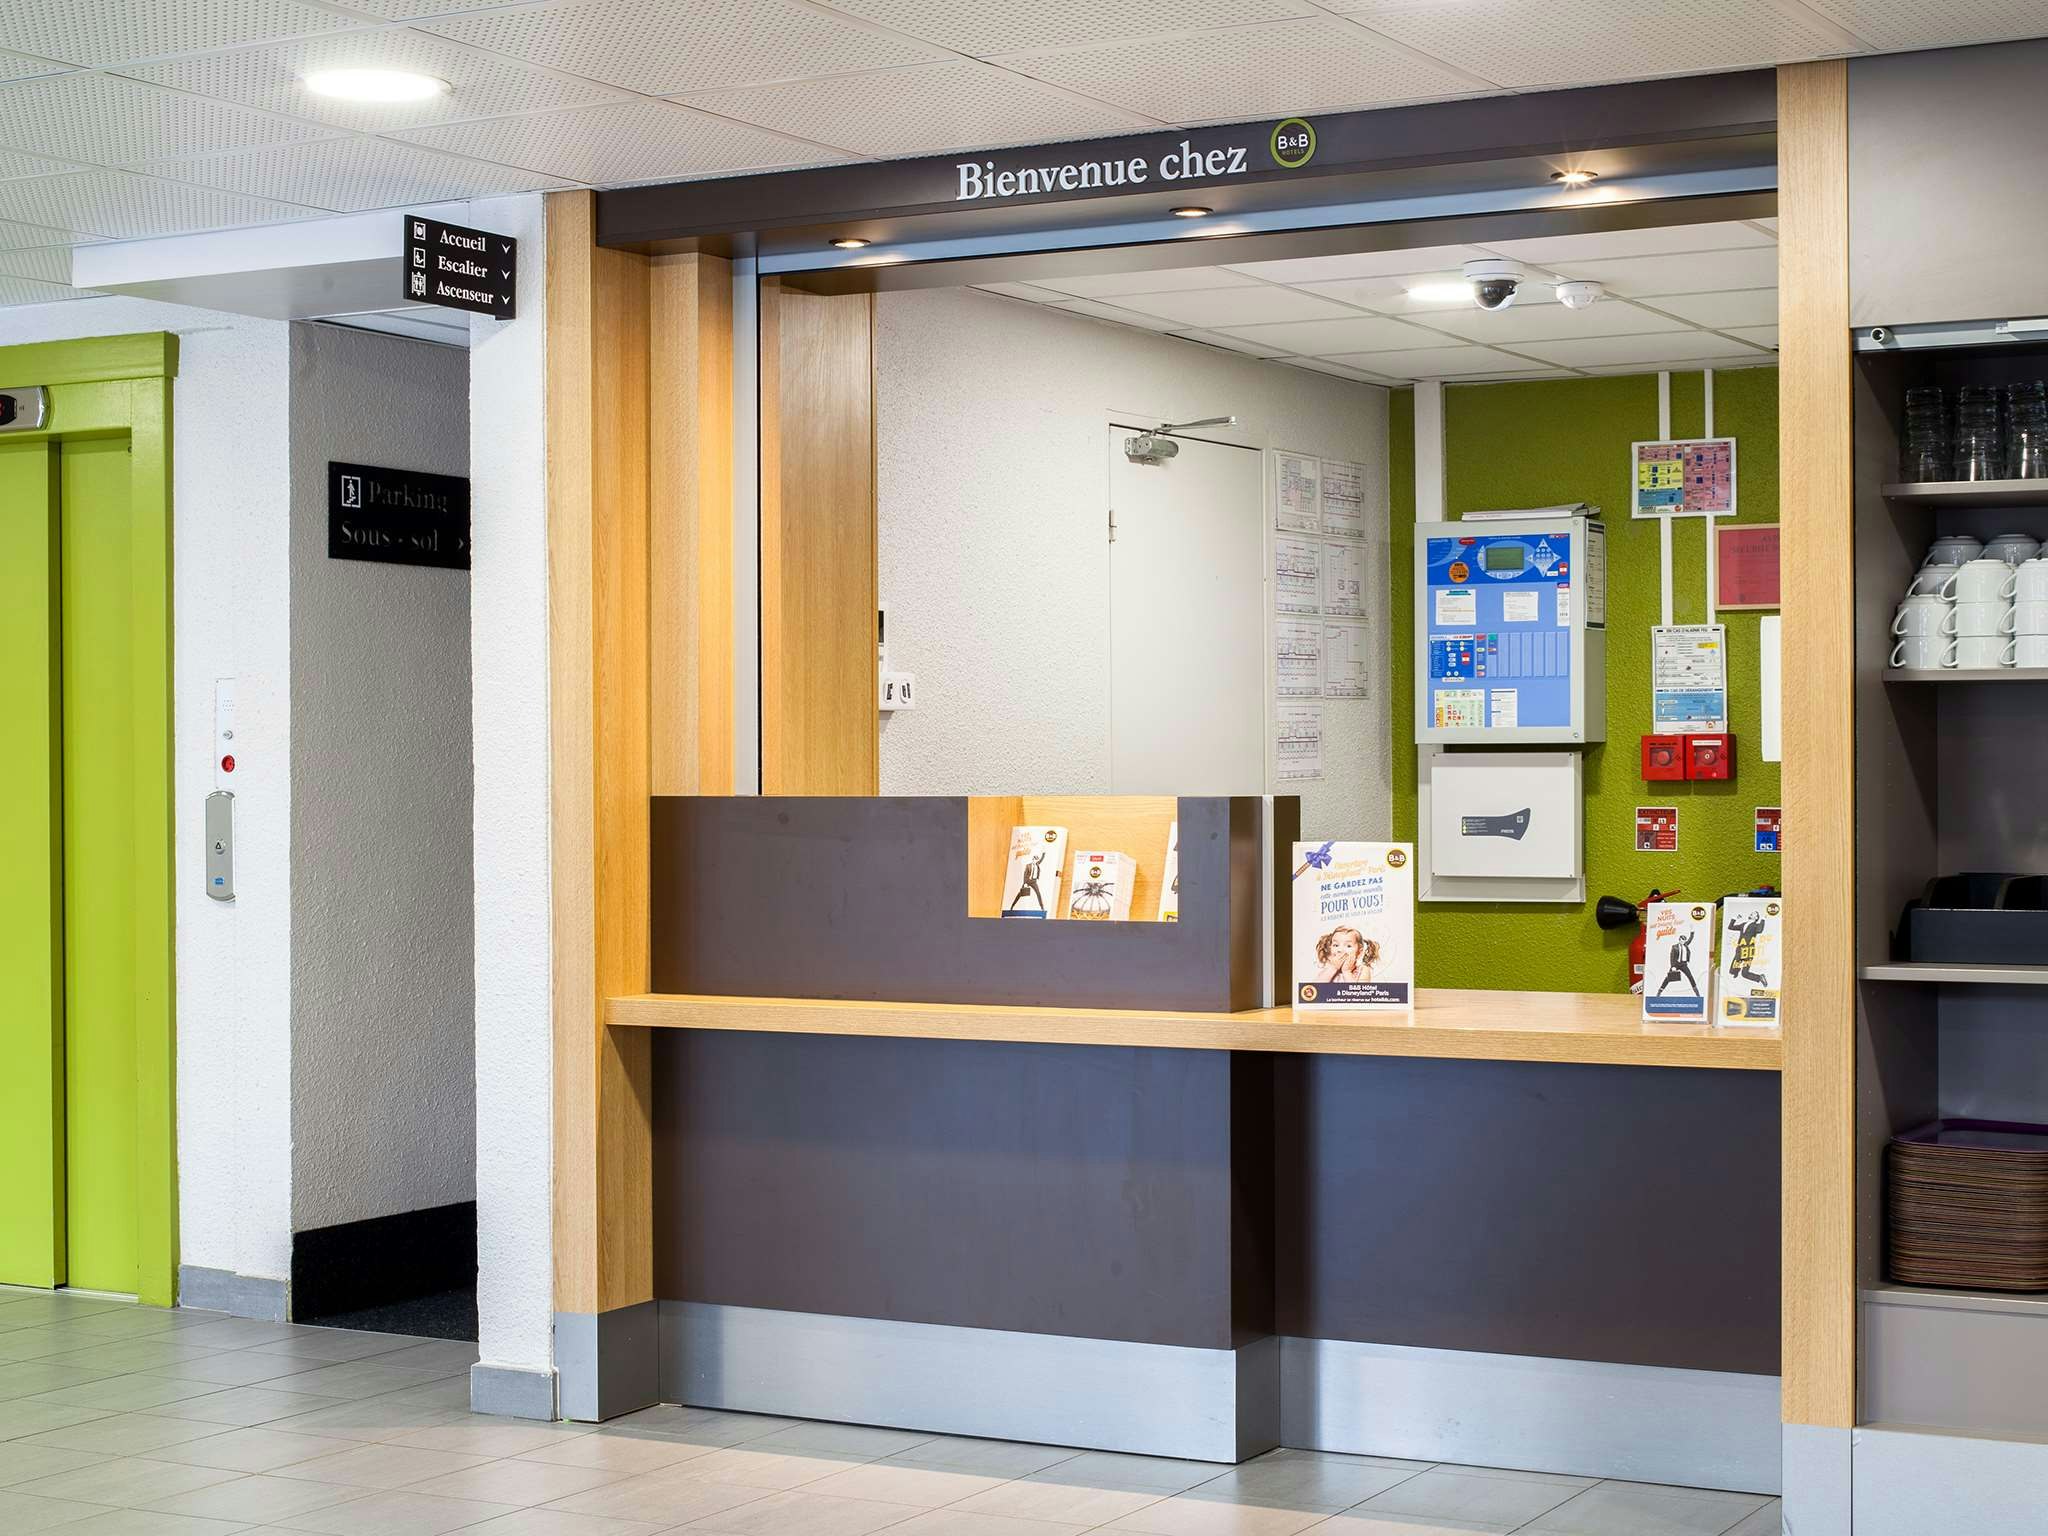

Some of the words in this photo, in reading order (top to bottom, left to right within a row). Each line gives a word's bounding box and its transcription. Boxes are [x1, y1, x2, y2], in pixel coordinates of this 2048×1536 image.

[1278, 133, 1309, 150] B&B
[956, 158, 1148, 201] Bienvenue
[1159, 140, 1248, 180] chez
[440, 229, 487, 252] Accueil
[438, 255, 488, 278] Escalier
[436, 280, 495, 304] Ascenseur
[368, 480, 448, 513] Parking
[341, 520, 392, 548] Sous
[411, 528, 439, 552] sol
[1321, 883, 1331, 891] NE
[1334, 878, 1367, 889] GARDEZ
[1368, 876, 1383, 885] PAS
[1321, 898, 1349, 914] POUR
